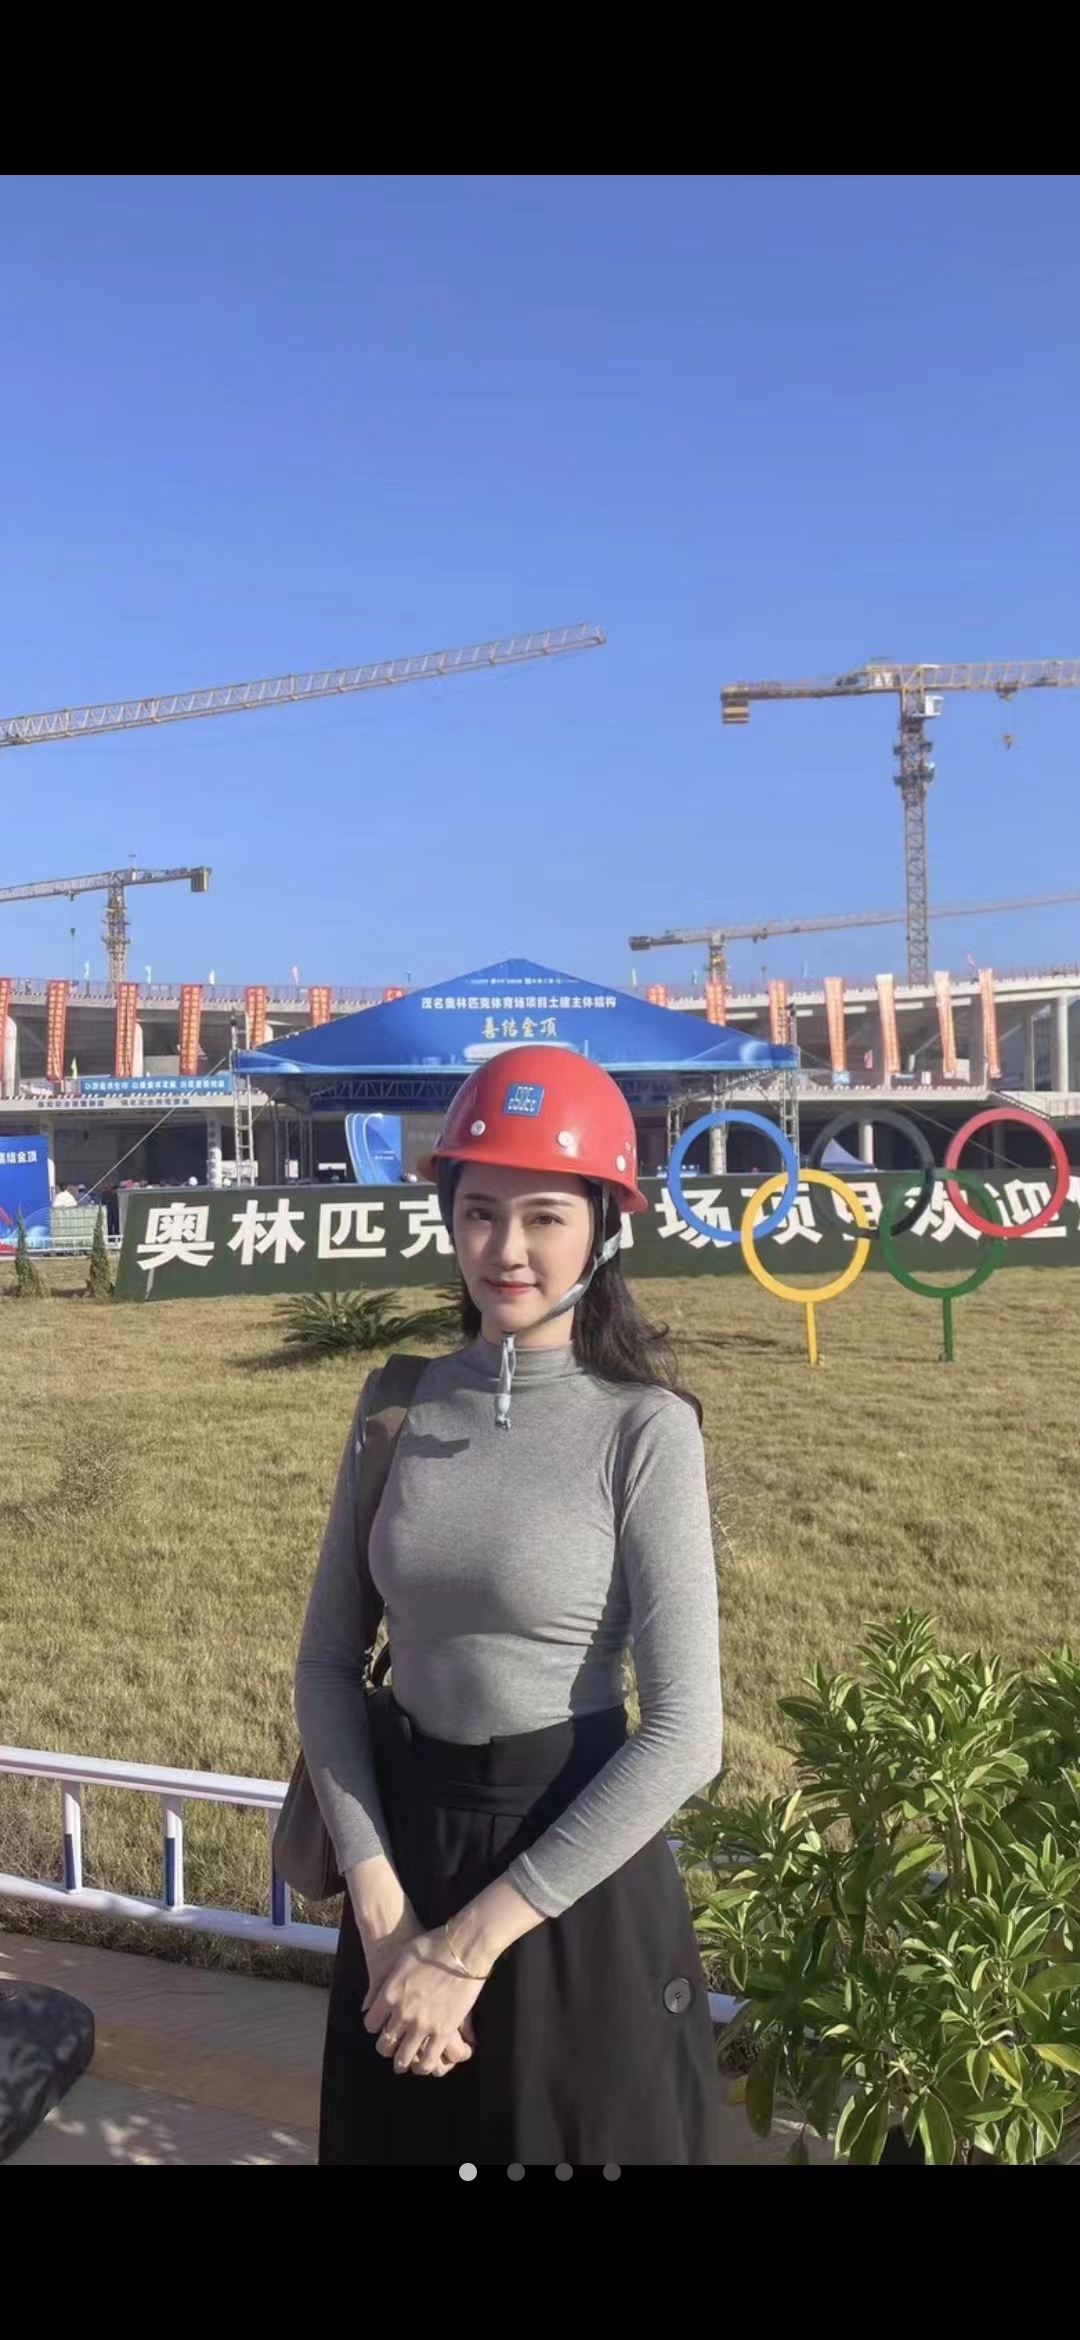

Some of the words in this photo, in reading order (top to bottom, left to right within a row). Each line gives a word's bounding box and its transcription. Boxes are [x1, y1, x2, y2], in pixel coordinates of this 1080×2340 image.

[421, 995, 617, 1010] 茂名奥林匹克体育场项目土建主体结构
[481, 1016, 558, 1039] 喜结金顶
